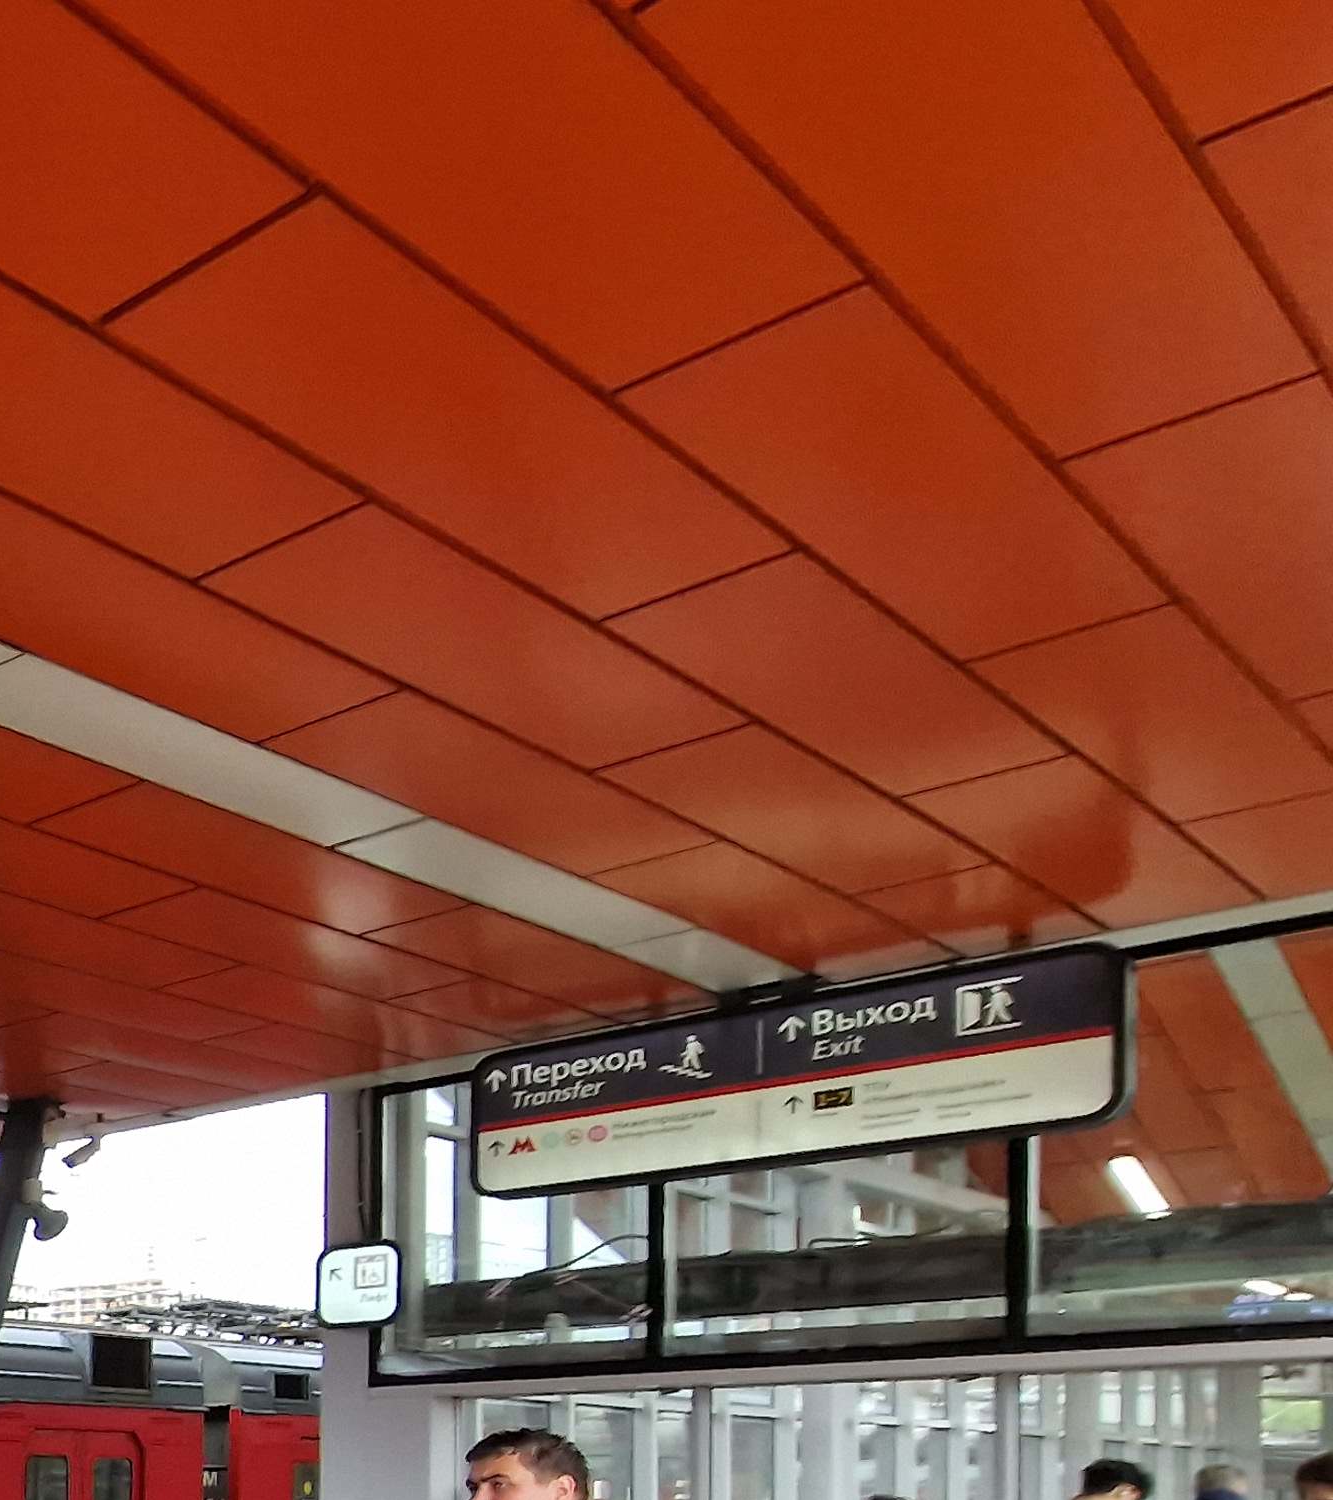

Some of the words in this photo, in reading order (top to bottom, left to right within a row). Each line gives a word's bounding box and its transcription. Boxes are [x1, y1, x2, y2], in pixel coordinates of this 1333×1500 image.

[811, 996, 939, 1038] Выход
[812, 1034, 866, 1061] Exit
[510, 1047, 648, 1089] Переход
[510, 1079, 607, 1110] Transfer
